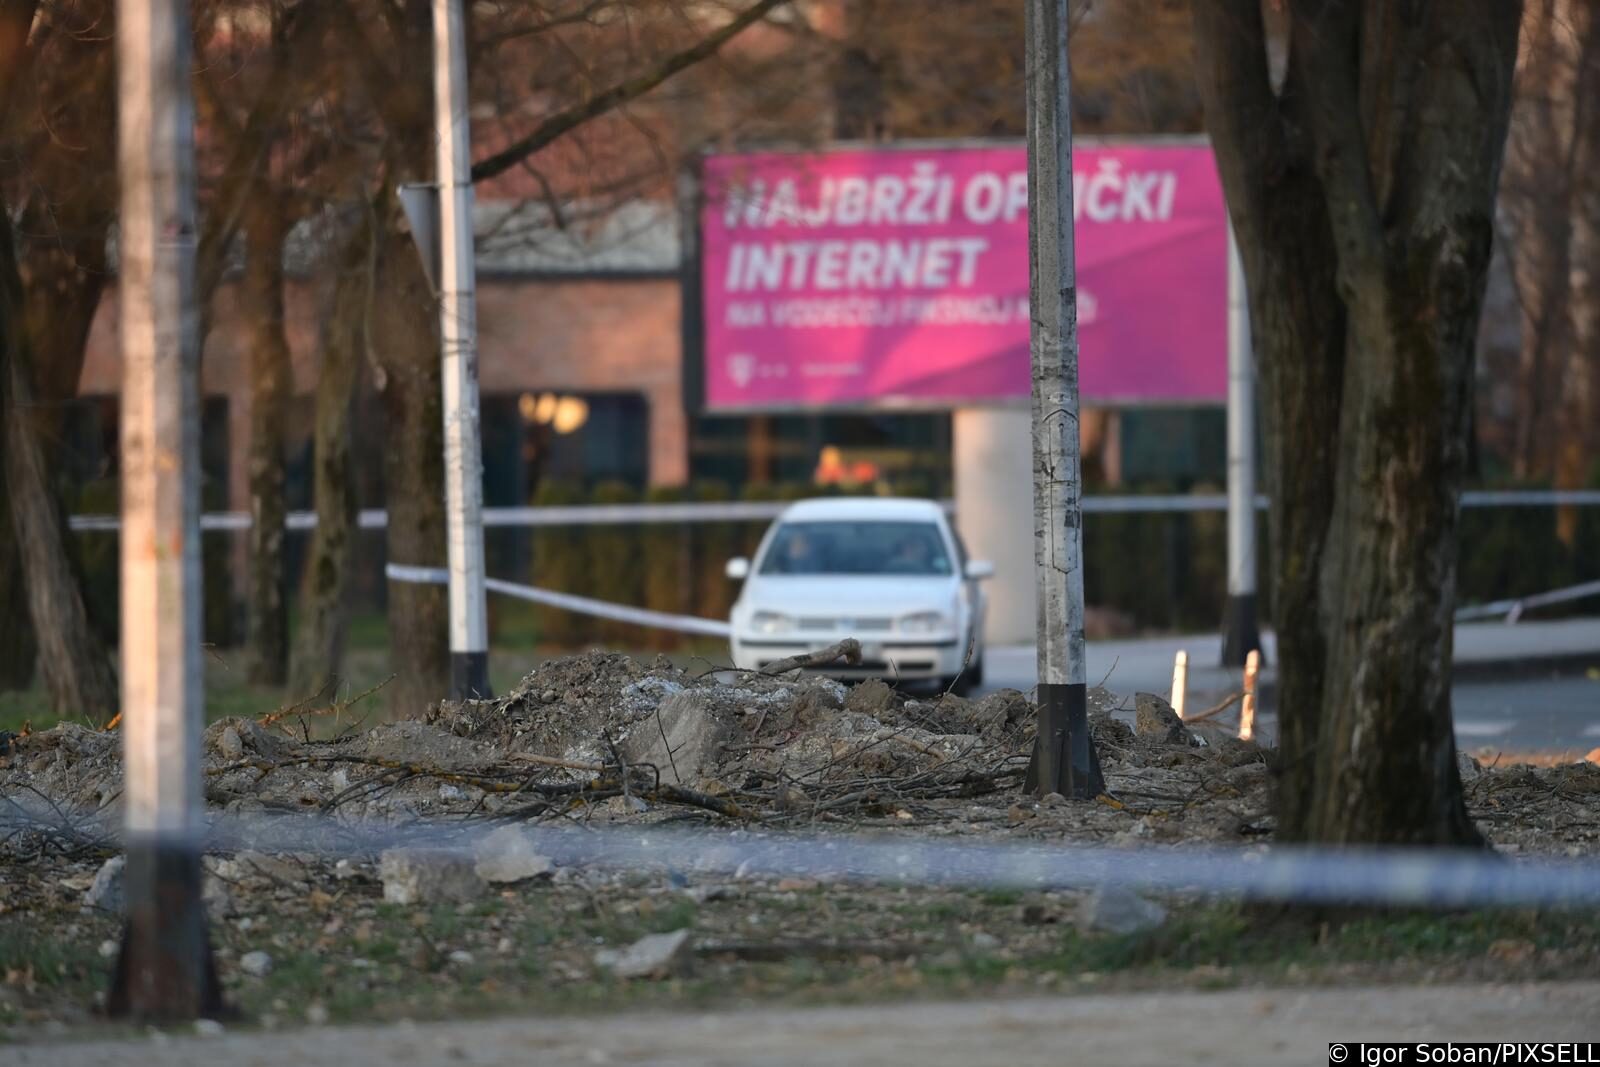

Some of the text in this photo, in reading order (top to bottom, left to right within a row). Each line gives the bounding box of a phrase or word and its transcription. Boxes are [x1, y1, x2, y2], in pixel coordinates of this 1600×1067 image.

[724, 159, 1177, 228] NAJBRŽI OPIČKI
[725, 237, 988, 291] INTERNET
